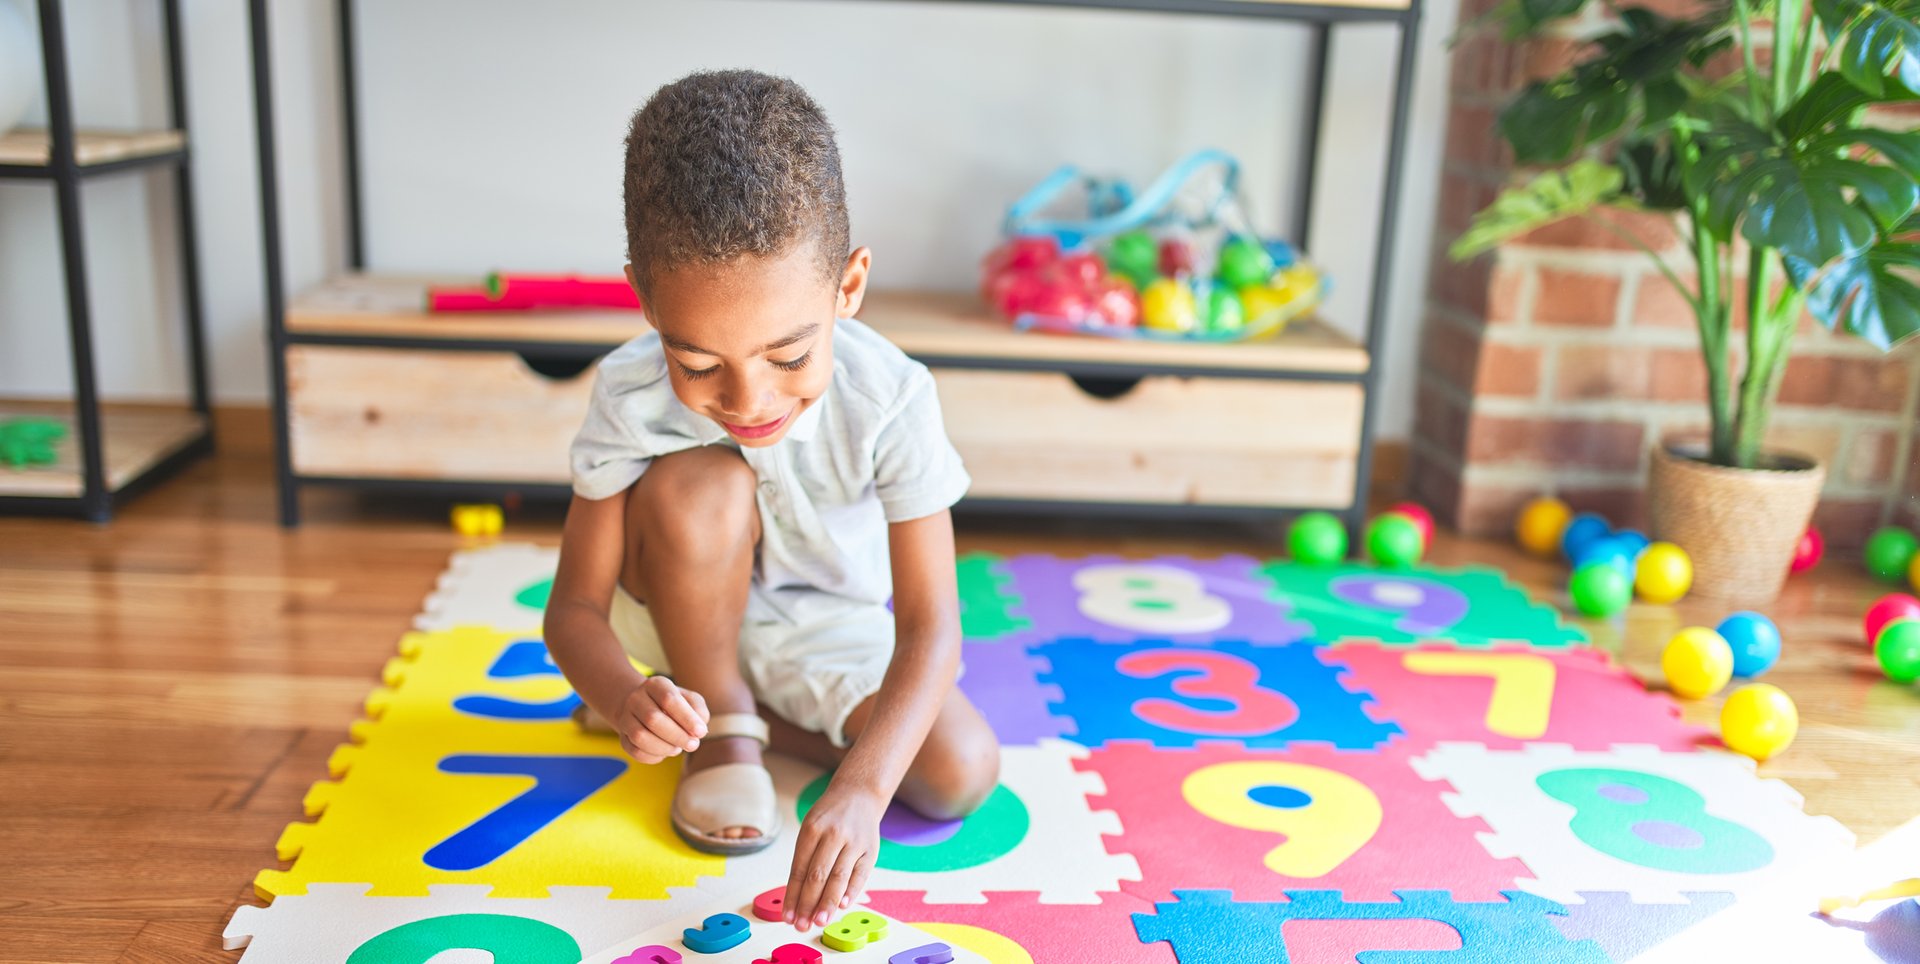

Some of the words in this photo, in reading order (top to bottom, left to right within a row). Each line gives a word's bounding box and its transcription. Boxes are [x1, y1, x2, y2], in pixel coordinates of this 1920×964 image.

[1073, 565, 1232, 634] 8
[1330, 576, 1468, 635] 9
[1117, 649, 1300, 736] 3
[1402, 651, 1556, 739] 7
[423, 755, 628, 870] 7
[1183, 761, 1382, 878] 9
[1536, 768, 1775, 874] 8
[821, 911, 889, 953] 8
